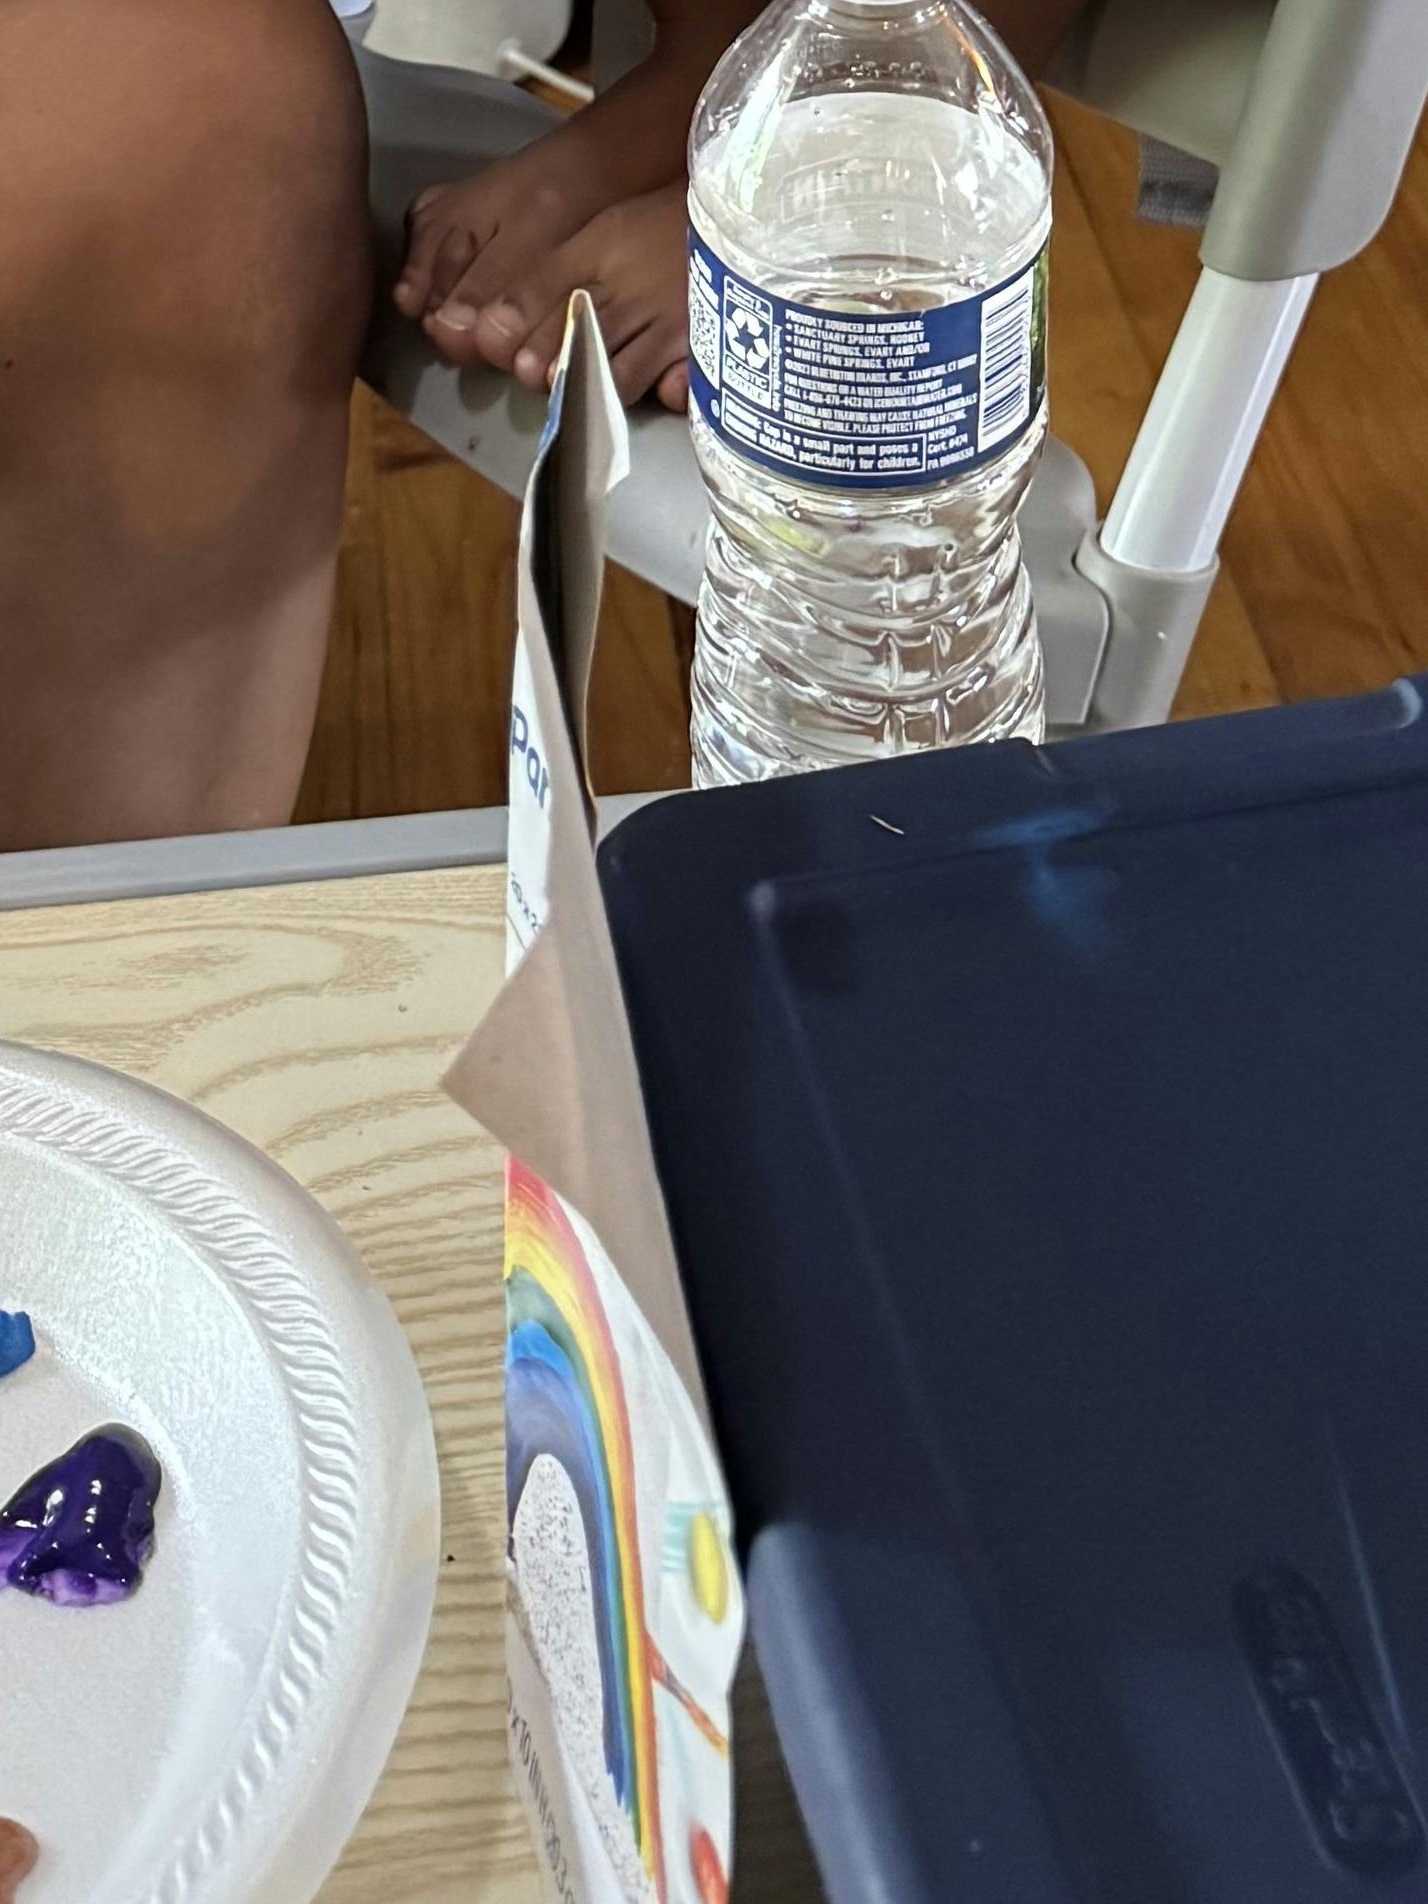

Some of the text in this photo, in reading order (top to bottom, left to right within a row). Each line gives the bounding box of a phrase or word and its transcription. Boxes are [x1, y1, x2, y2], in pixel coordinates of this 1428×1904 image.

[785, 309, 823, 328] PROUDLY
[793, 324, 846, 343] SANCTUARY
[793, 335, 821, 352] EVART
[864, 343, 893, 357] EVART
[793, 347, 821, 362] WHITE
[886, 356, 915, 368] EVART
[726, 355, 770, 392] PLASTIC
[833, 442, 853, 456] part
[799, 450, 856, 471] particularly
